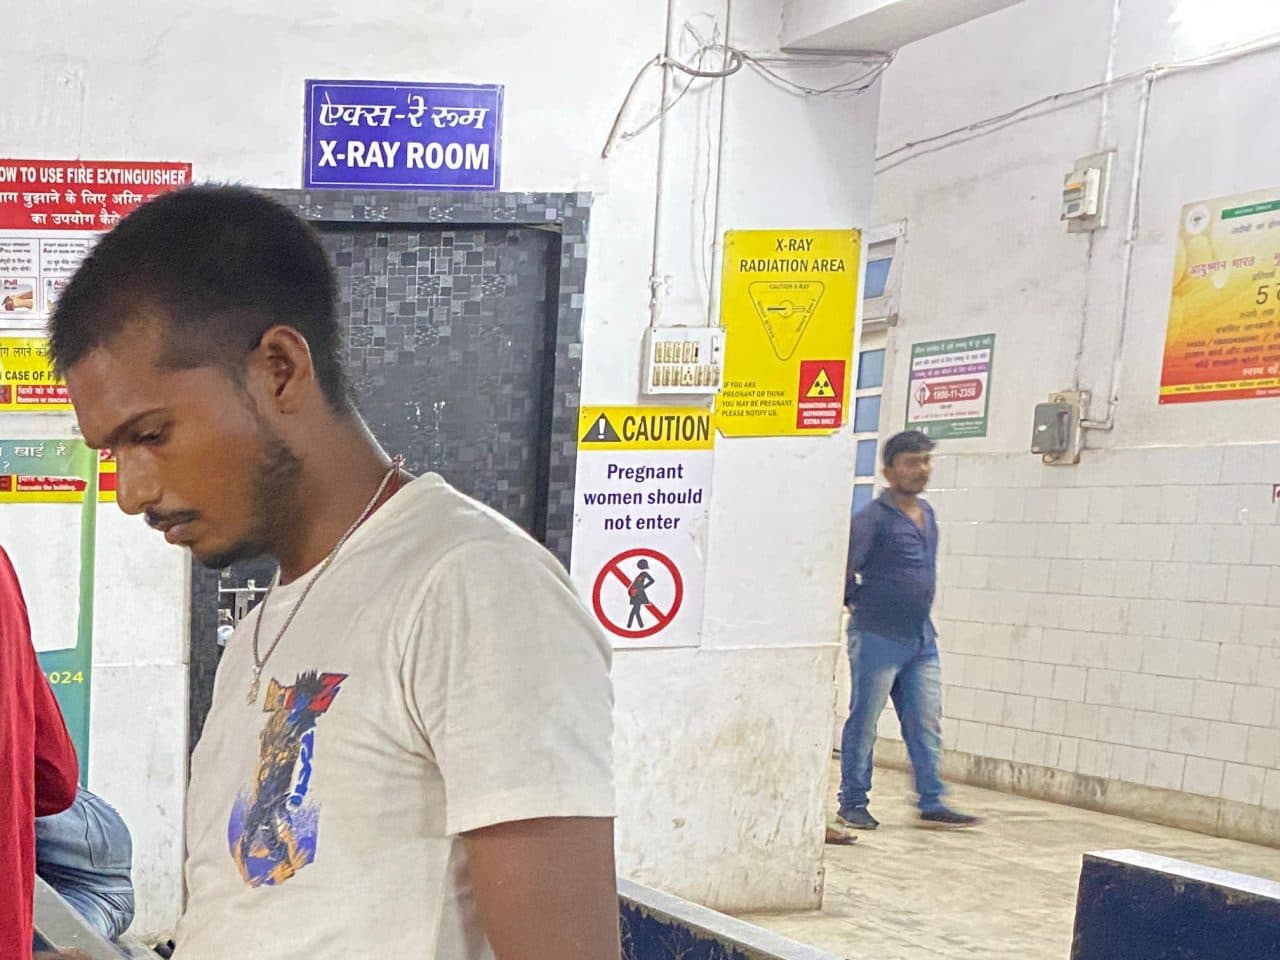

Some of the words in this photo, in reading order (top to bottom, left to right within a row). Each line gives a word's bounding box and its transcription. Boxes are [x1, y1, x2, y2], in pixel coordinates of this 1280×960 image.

[431, 105, 490, 129] रूम
[318, 140, 400, 169] X-RAY
[406, 142, 489, 170] ROOM
[20, 167, 37, 183] TO
[40, 167, 64, 183] USE
[66, 167, 94, 184] FIRE
[97, 168, 186, 185] EXTINGUISHER
[23, 189, 60, 208] बुझाने
[65, 189, 77, 203] के
[81, 189, 107, 207] लिए
[30, 212, 48, 225] का
[52, 211, 95, 225] उपयोग
[776, 238, 813, 252] X-RAY
[740, 259, 809, 273] RADIATION
[811, 259, 845, 273] AREA
[1255, 284, 1268, 305] 5
[5, 371, 30, 380] CASE
[32, 371, 45, 380] OF
[622, 415, 710, 442] CAUTION
[14, 443, 44, 457] खाई
[2, 461, 10, 473] ?
[607, 463, 684, 483] Pregnant
[584, 492, 642, 505] women
[647, 488, 703, 505] should
[604, 514, 632, 530] not
[636, 514, 681, 530] enter
